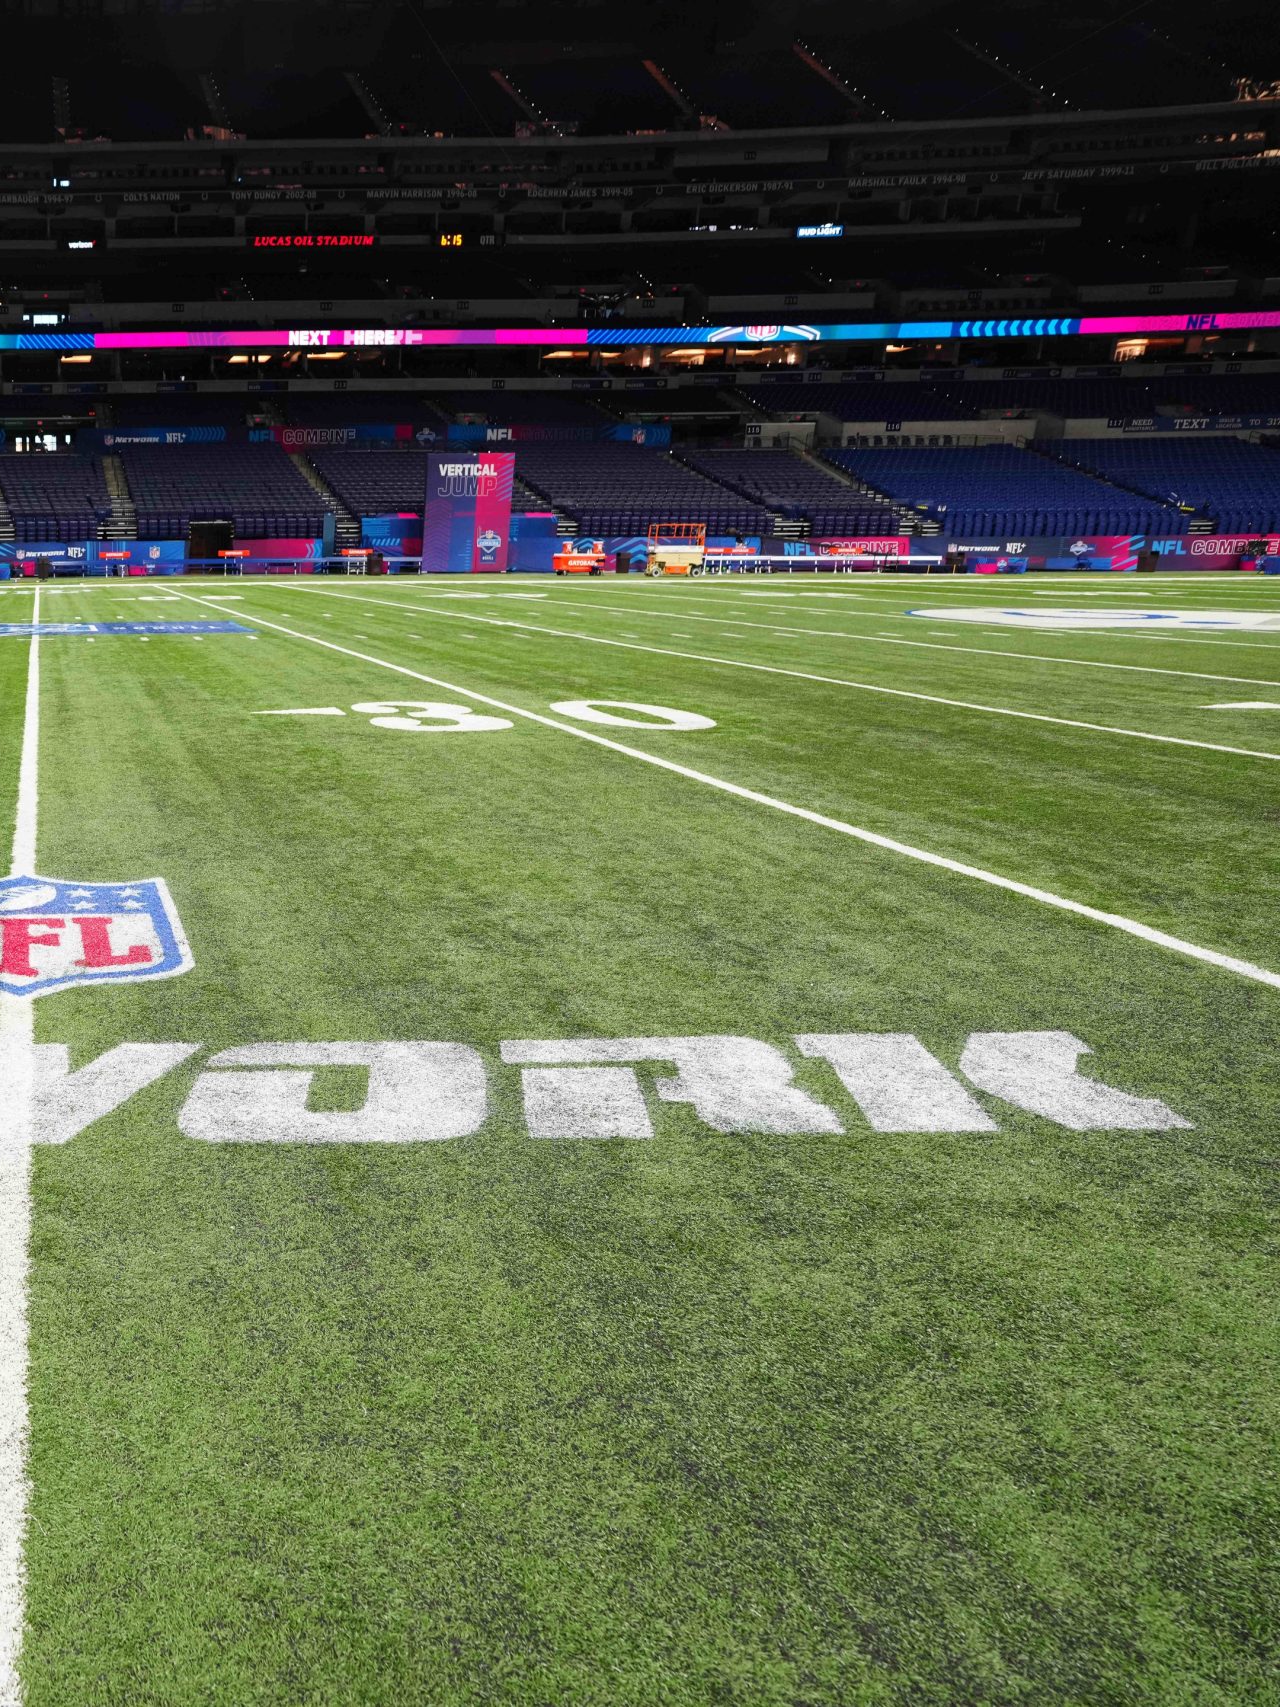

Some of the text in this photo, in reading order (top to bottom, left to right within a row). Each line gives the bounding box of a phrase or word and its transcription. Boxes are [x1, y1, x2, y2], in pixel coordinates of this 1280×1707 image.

[1022, 166, 1134, 181] JEFF SATURDAY 1999-11
[686, 181, 794, 194] ERIC DICKERSON 1987-91
[848, 177, 897, 188] MARSHALL
[898, 175, 927, 186] FAULK
[123, 192, 180, 202] COLTS NATION
[231, 190, 317, 201] TONY DUNGY 2002-08
[366, 190, 399, 199] MARVIN
[401, 189, 443, 199] HARRISON
[527, 187, 633, 198] EDGERRIN JAMES 1999-05
[798, 226, 842, 237] BUD LIGHT
[68, 241, 93, 249] verizon
[254, 235, 374, 247] LUCAS OIL STADIUM
[440, 234, 495, 246] 6:15 QTR
[1186, 314, 1220, 330] NFL
[288, 330, 396, 345] NEXT HERE
[1109, 419, 1123, 427] 117
[1131, 418, 1154, 426] NEED
[1174, 418, 1210, 429] TEXT
[1248, 418, 1261, 426] TO
[115, 431, 187, 444] NETWORK NFL+
[249, 428, 356, 445] NFL COMBINE
[486, 428, 517, 441] NFL
[438, 463, 498, 477] VERTICAL
[437, 476, 498, 497] JUMP
[25, 546, 86, 558] NETWORK NFL+
[783, 541, 899, 557] NFL COMBINE
[957, 542, 1026, 554] NETWORK NFL+
[1151, 538, 1279, 556] NFL COMBE
